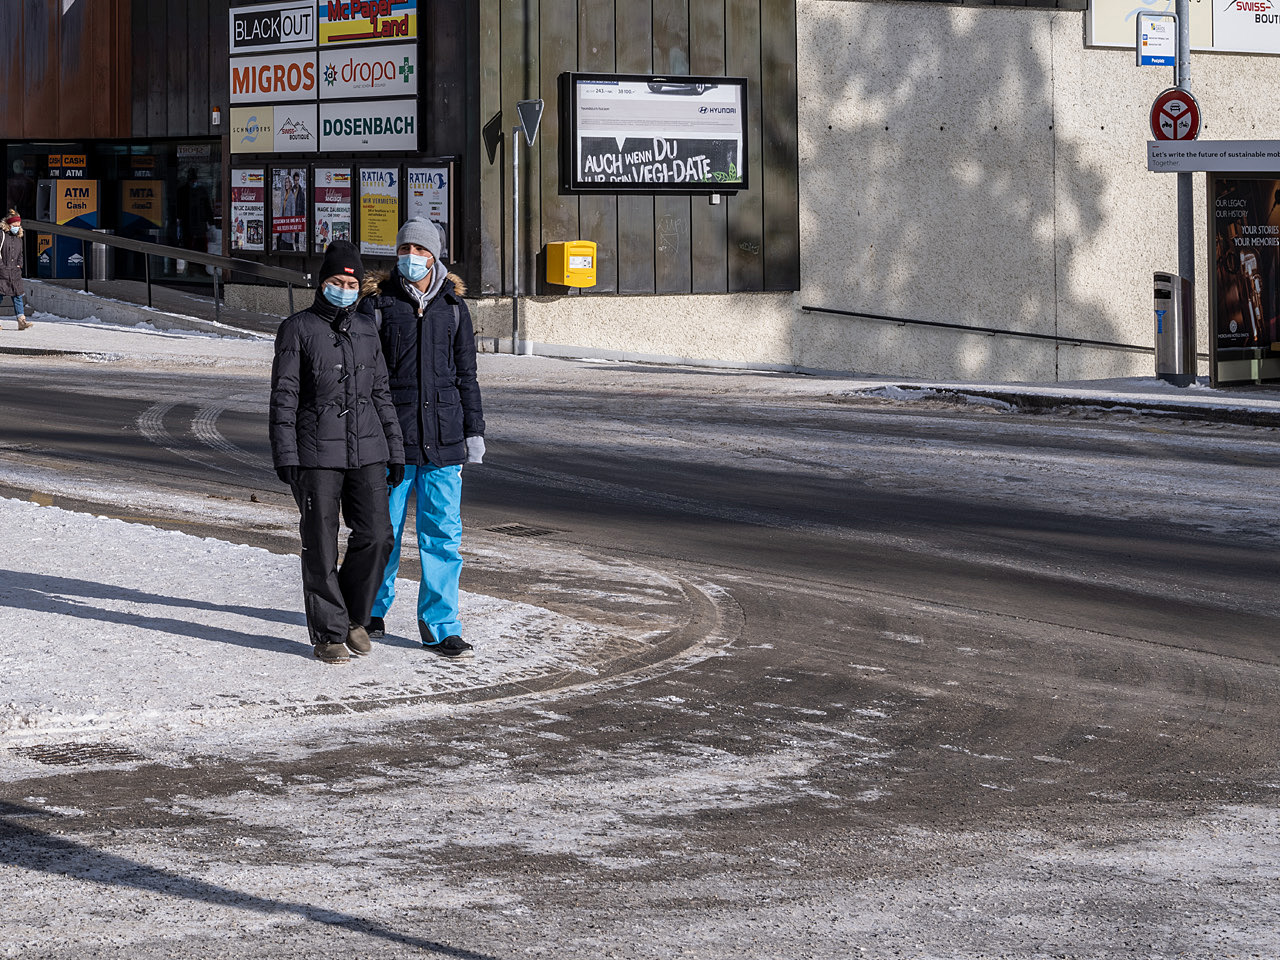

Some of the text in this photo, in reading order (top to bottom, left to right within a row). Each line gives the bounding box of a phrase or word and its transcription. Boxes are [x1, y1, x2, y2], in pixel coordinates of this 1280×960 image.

[235, 13, 311, 41] BLACKOUT
[373, 14, 409, 37] Land
[341, 57, 396, 87] dropa
[232, 61, 315, 95] MIGROS
[323, 116, 414, 136] DOSENBACH
[584, 136, 677, 175] AUCH WENN DU
[632, 155, 712, 183] VEGI-DATE
[361, 171, 384, 182] RÄTIA
[409, 172, 433, 183] RÄTIA
[64, 187, 89, 198] ATM
[66, 201, 87, 209] Cash
[1215, 199, 1247, 207] OUR LEGACY
[1215, 210, 1248, 218] OUR HISTORY
[1241, 225, 1279, 234] YOUR STORIES
[1234, 237, 1279, 246] YOUR MEMORIES
